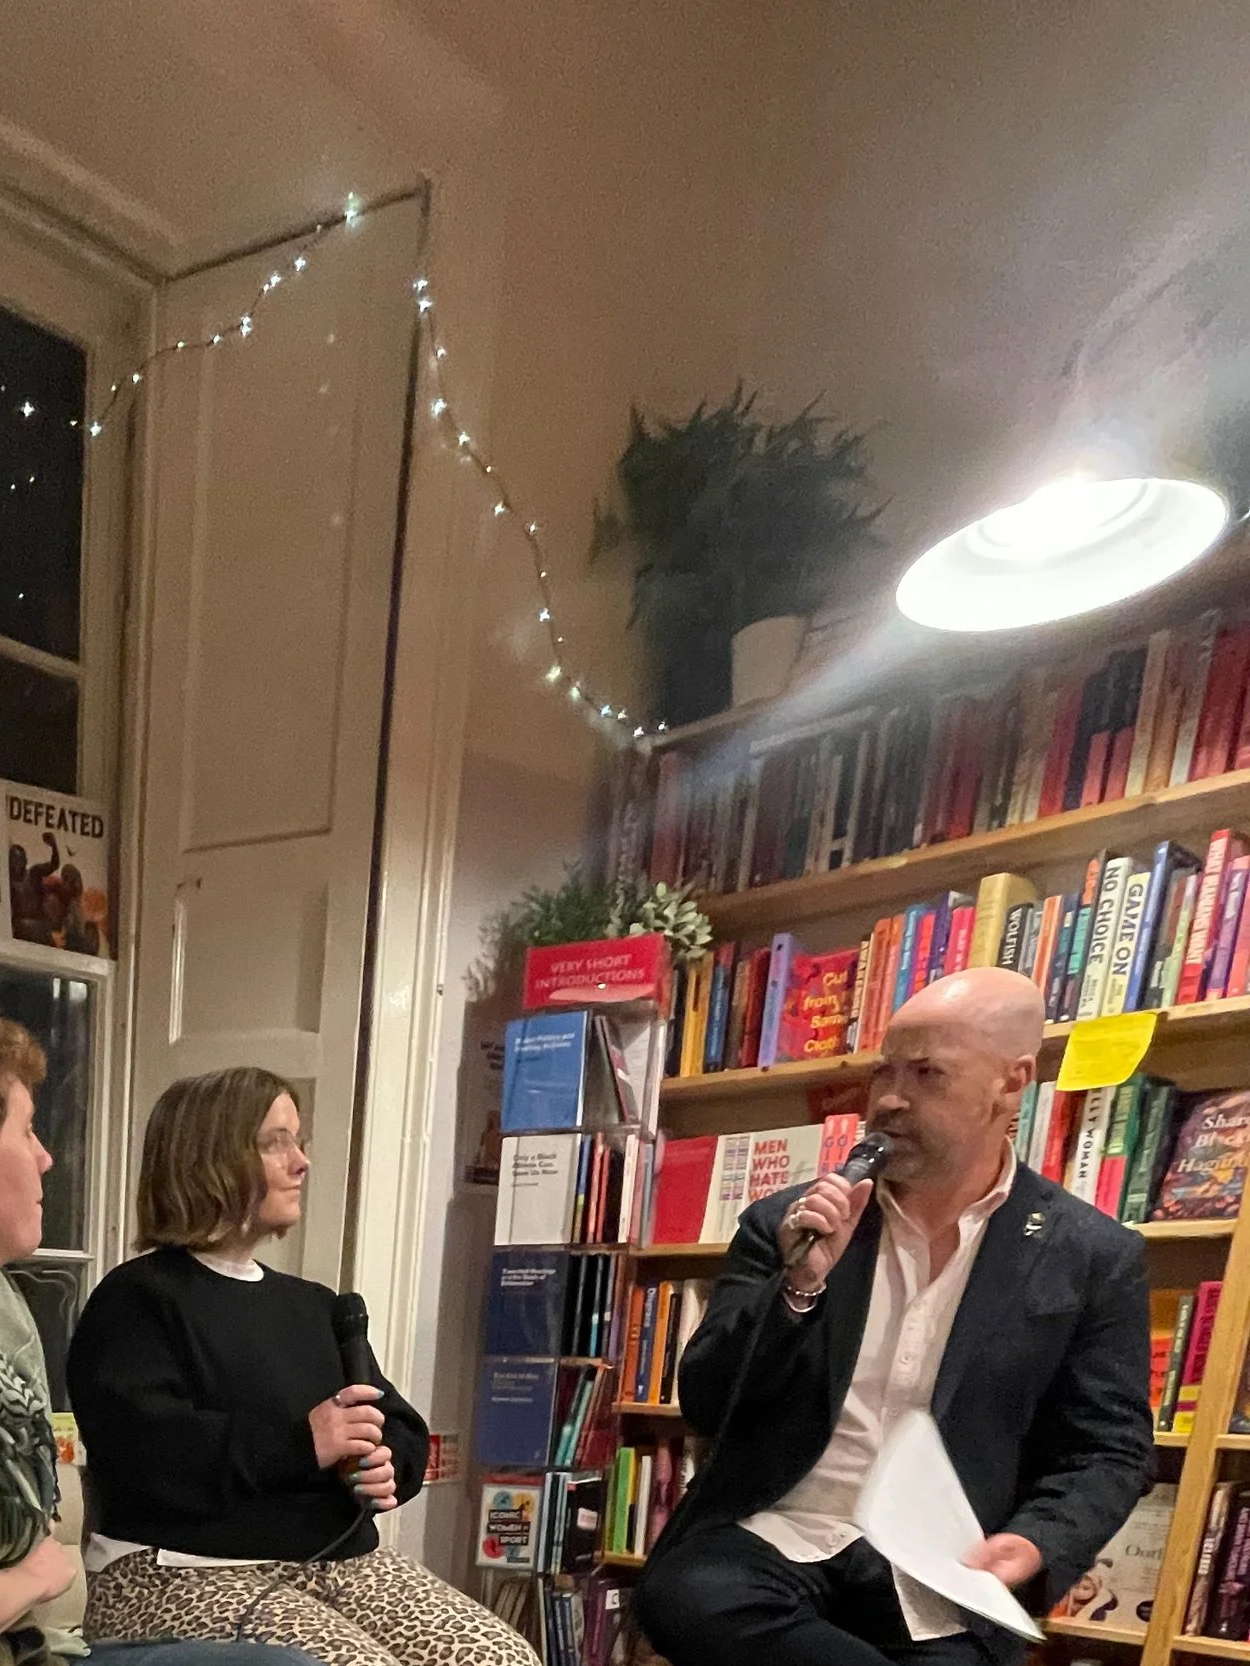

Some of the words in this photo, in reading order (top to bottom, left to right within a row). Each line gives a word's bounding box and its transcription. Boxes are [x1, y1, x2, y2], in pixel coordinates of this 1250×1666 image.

[8, 795, 104, 839] DEFEATED
[1100, 865, 1121, 892] NO
[1119, 883, 1143, 943] GAME
[1002, 908, 1022, 966] WOLFISH
[1089, 899, 1114, 964] CHOICE
[550, 959, 585, 974] VERY
[587, 954, 632, 969] SHORT
[1114, 949, 1131, 976] ON
[534, 968, 645, 989] INTRODUCTIONS
[754, 1139, 788, 1155] MEN
[1077, 1130, 1095, 1178] WOMAN
[752, 1155, 791, 1171] WHO
[749, 1171, 790, 1187] HATE
[489, 1523, 521, 1533] WOMEN
[500, 1536, 528, 1545] SPORT
